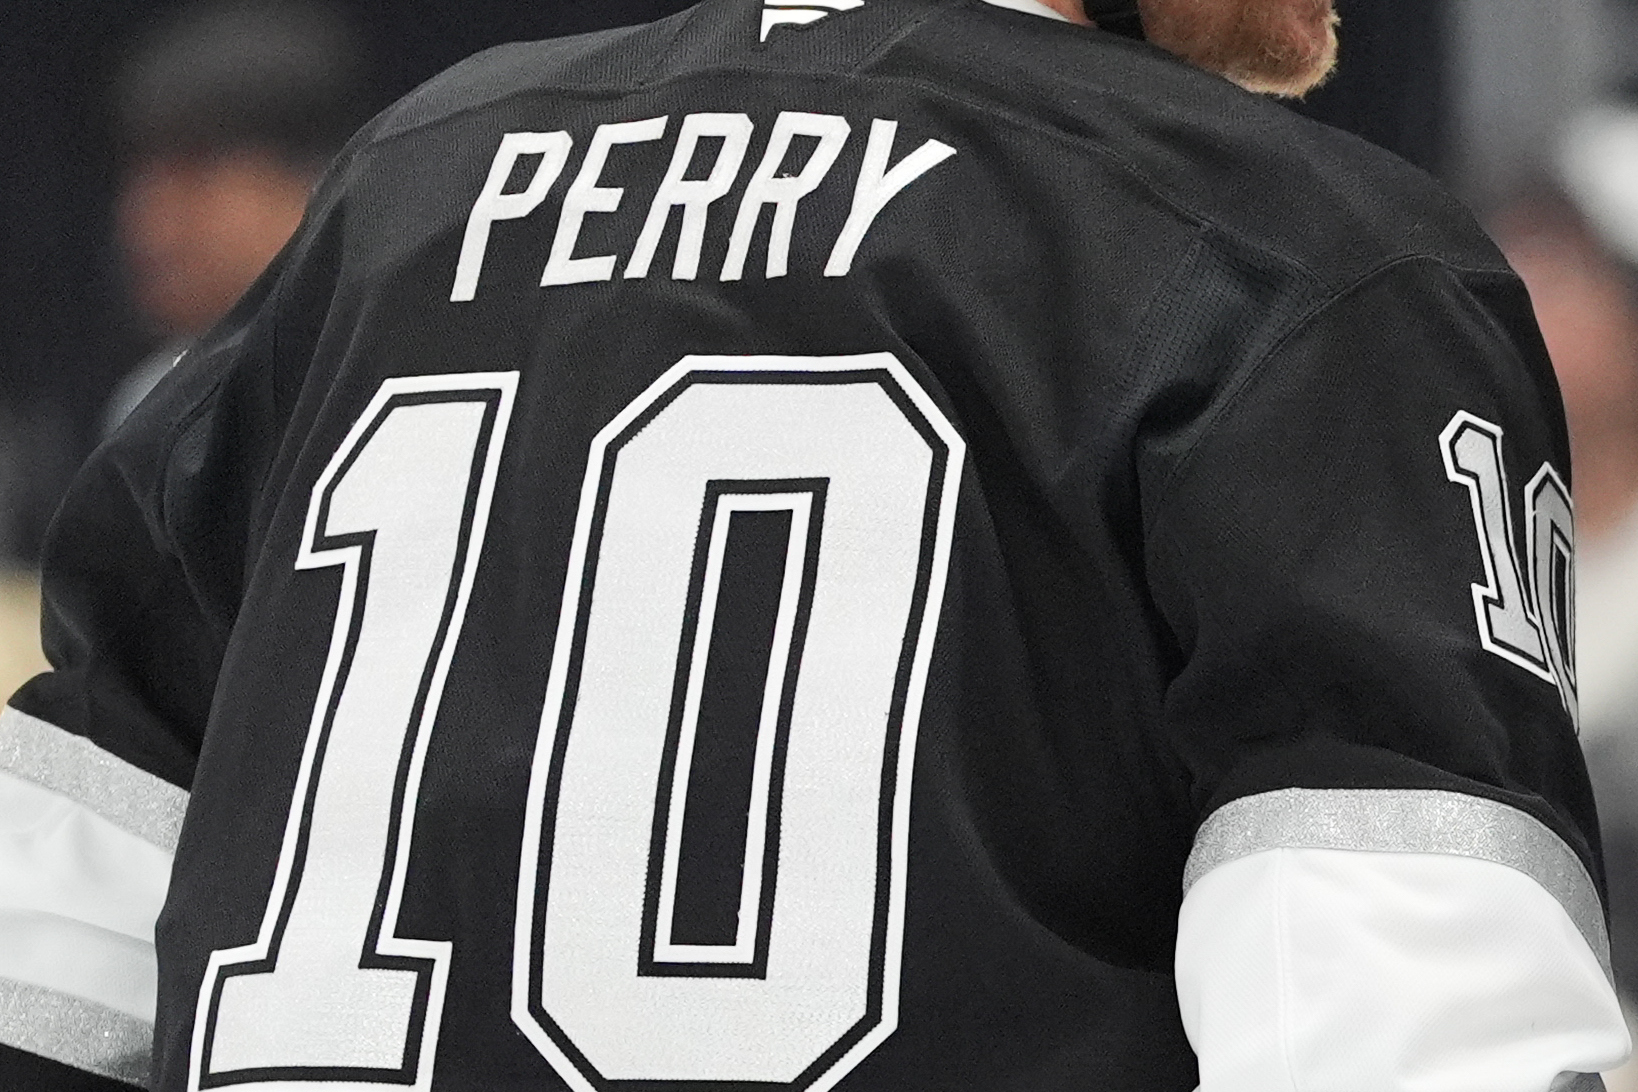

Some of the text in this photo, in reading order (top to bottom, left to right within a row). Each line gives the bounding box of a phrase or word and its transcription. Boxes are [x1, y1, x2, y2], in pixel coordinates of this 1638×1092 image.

[449, 110, 957, 303] PERRY
[186, 351, 968, 1092] 10
[1438, 410, 1580, 737] 10
